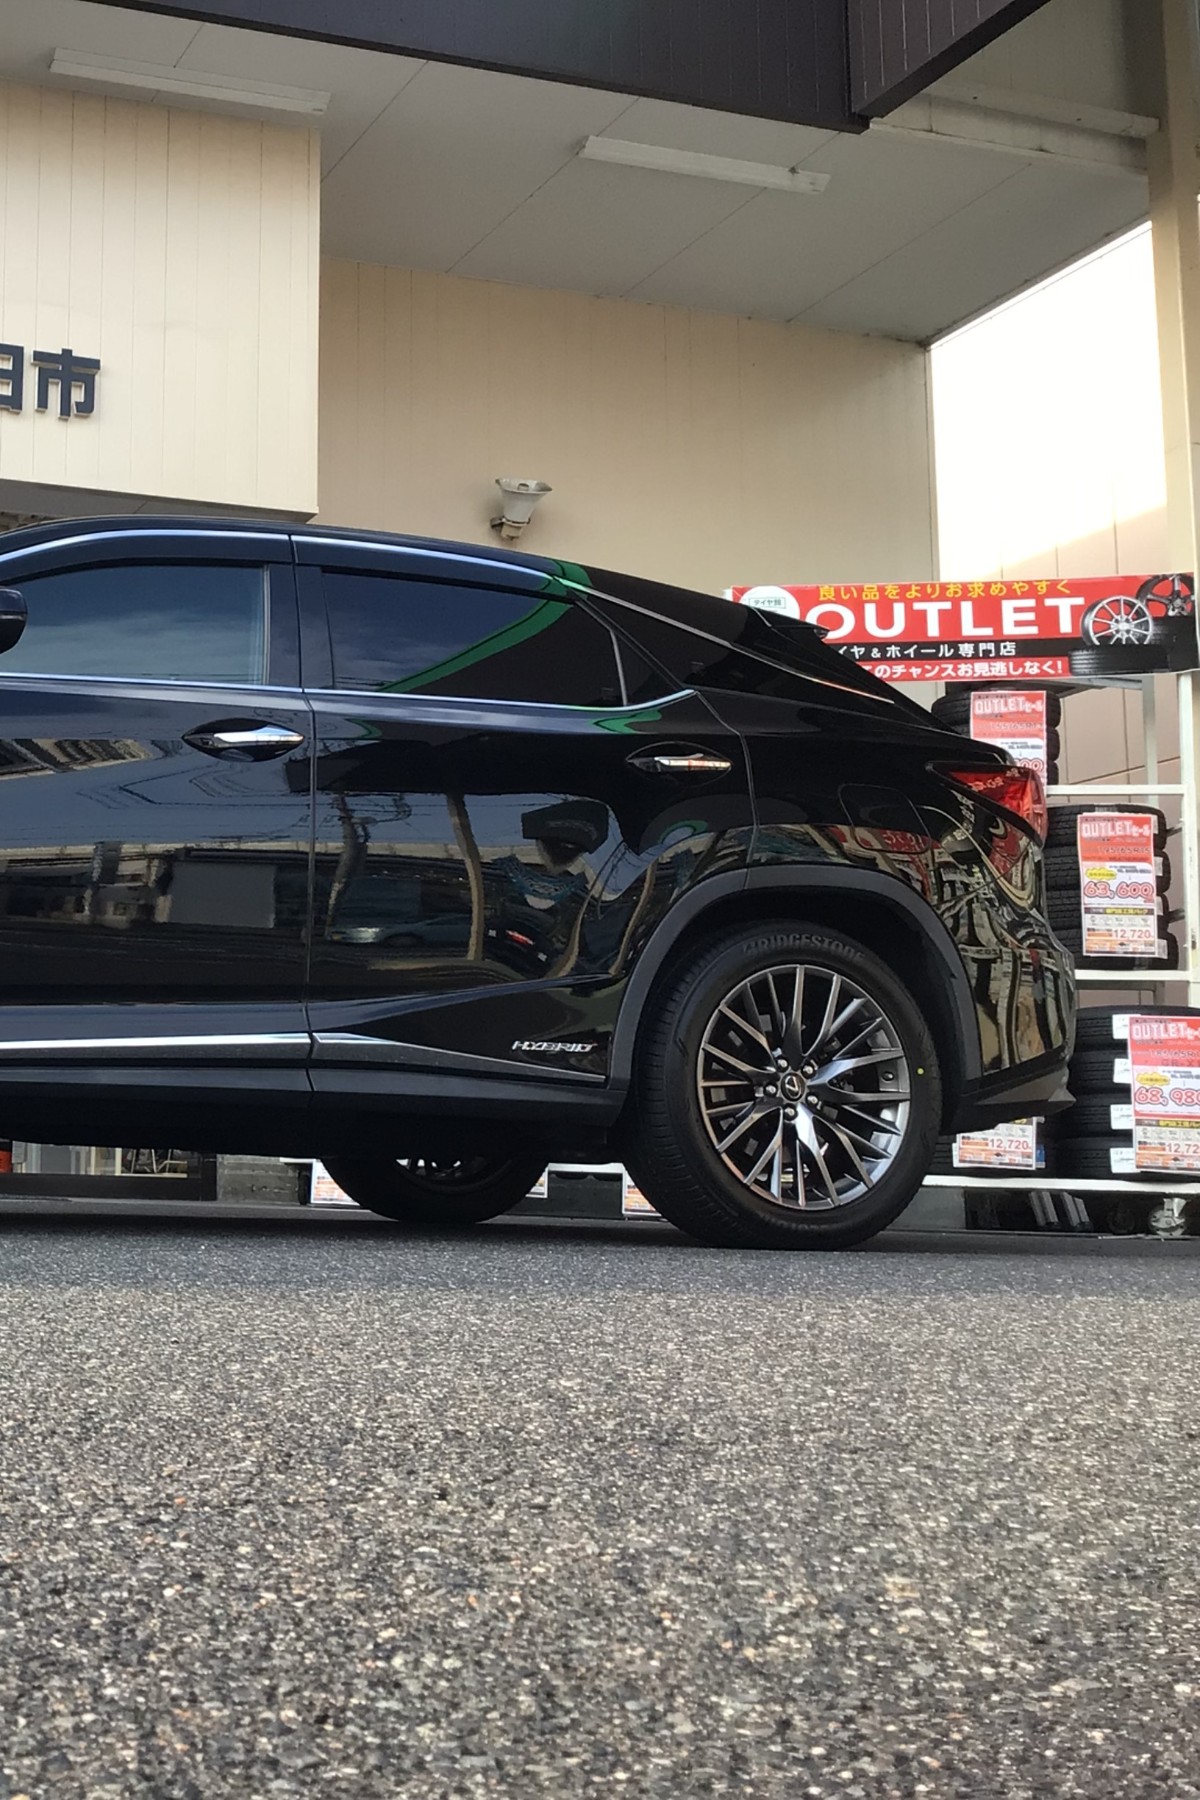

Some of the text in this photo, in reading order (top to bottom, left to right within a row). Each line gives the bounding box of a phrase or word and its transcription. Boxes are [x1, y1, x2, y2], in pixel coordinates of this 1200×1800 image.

[818, 578, 1072, 602] 良い品をよりお求めやすく
[805, 596, 1085, 640] OUTLET
[1084, 881, 1154, 899] 63,600
[742, 932, 865, 962] BRIDGESTONE
